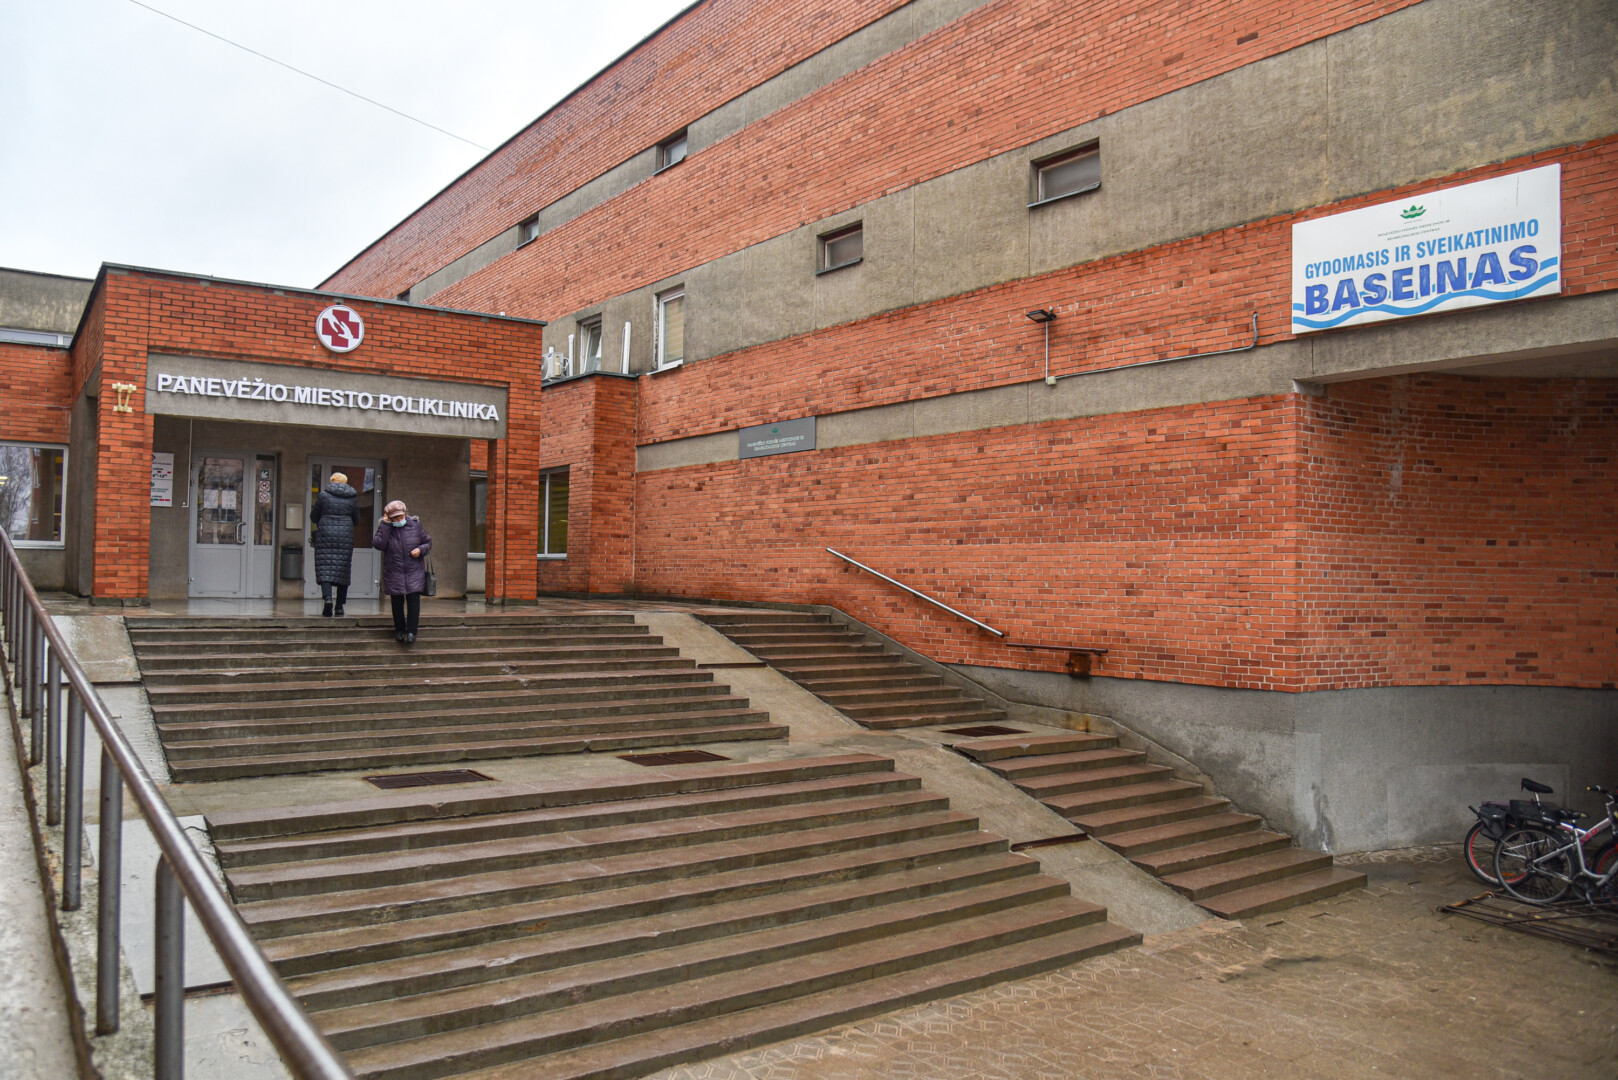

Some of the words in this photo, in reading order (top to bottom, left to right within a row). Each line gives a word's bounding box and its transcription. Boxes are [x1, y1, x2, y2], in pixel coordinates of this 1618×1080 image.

[1305, 249, 1390, 279] GYDOMASIS
[1395, 245, 1411, 262] IR
[1416, 218, 1539, 259] SVEIKATINIMO
[1305, 245, 1539, 316] BASEINAS
[157, 373, 288, 402] PANEVĖŽIO
[294, 386, 373, 409] MIESTO
[379, 393, 499, 421] POLIKLINIKA
